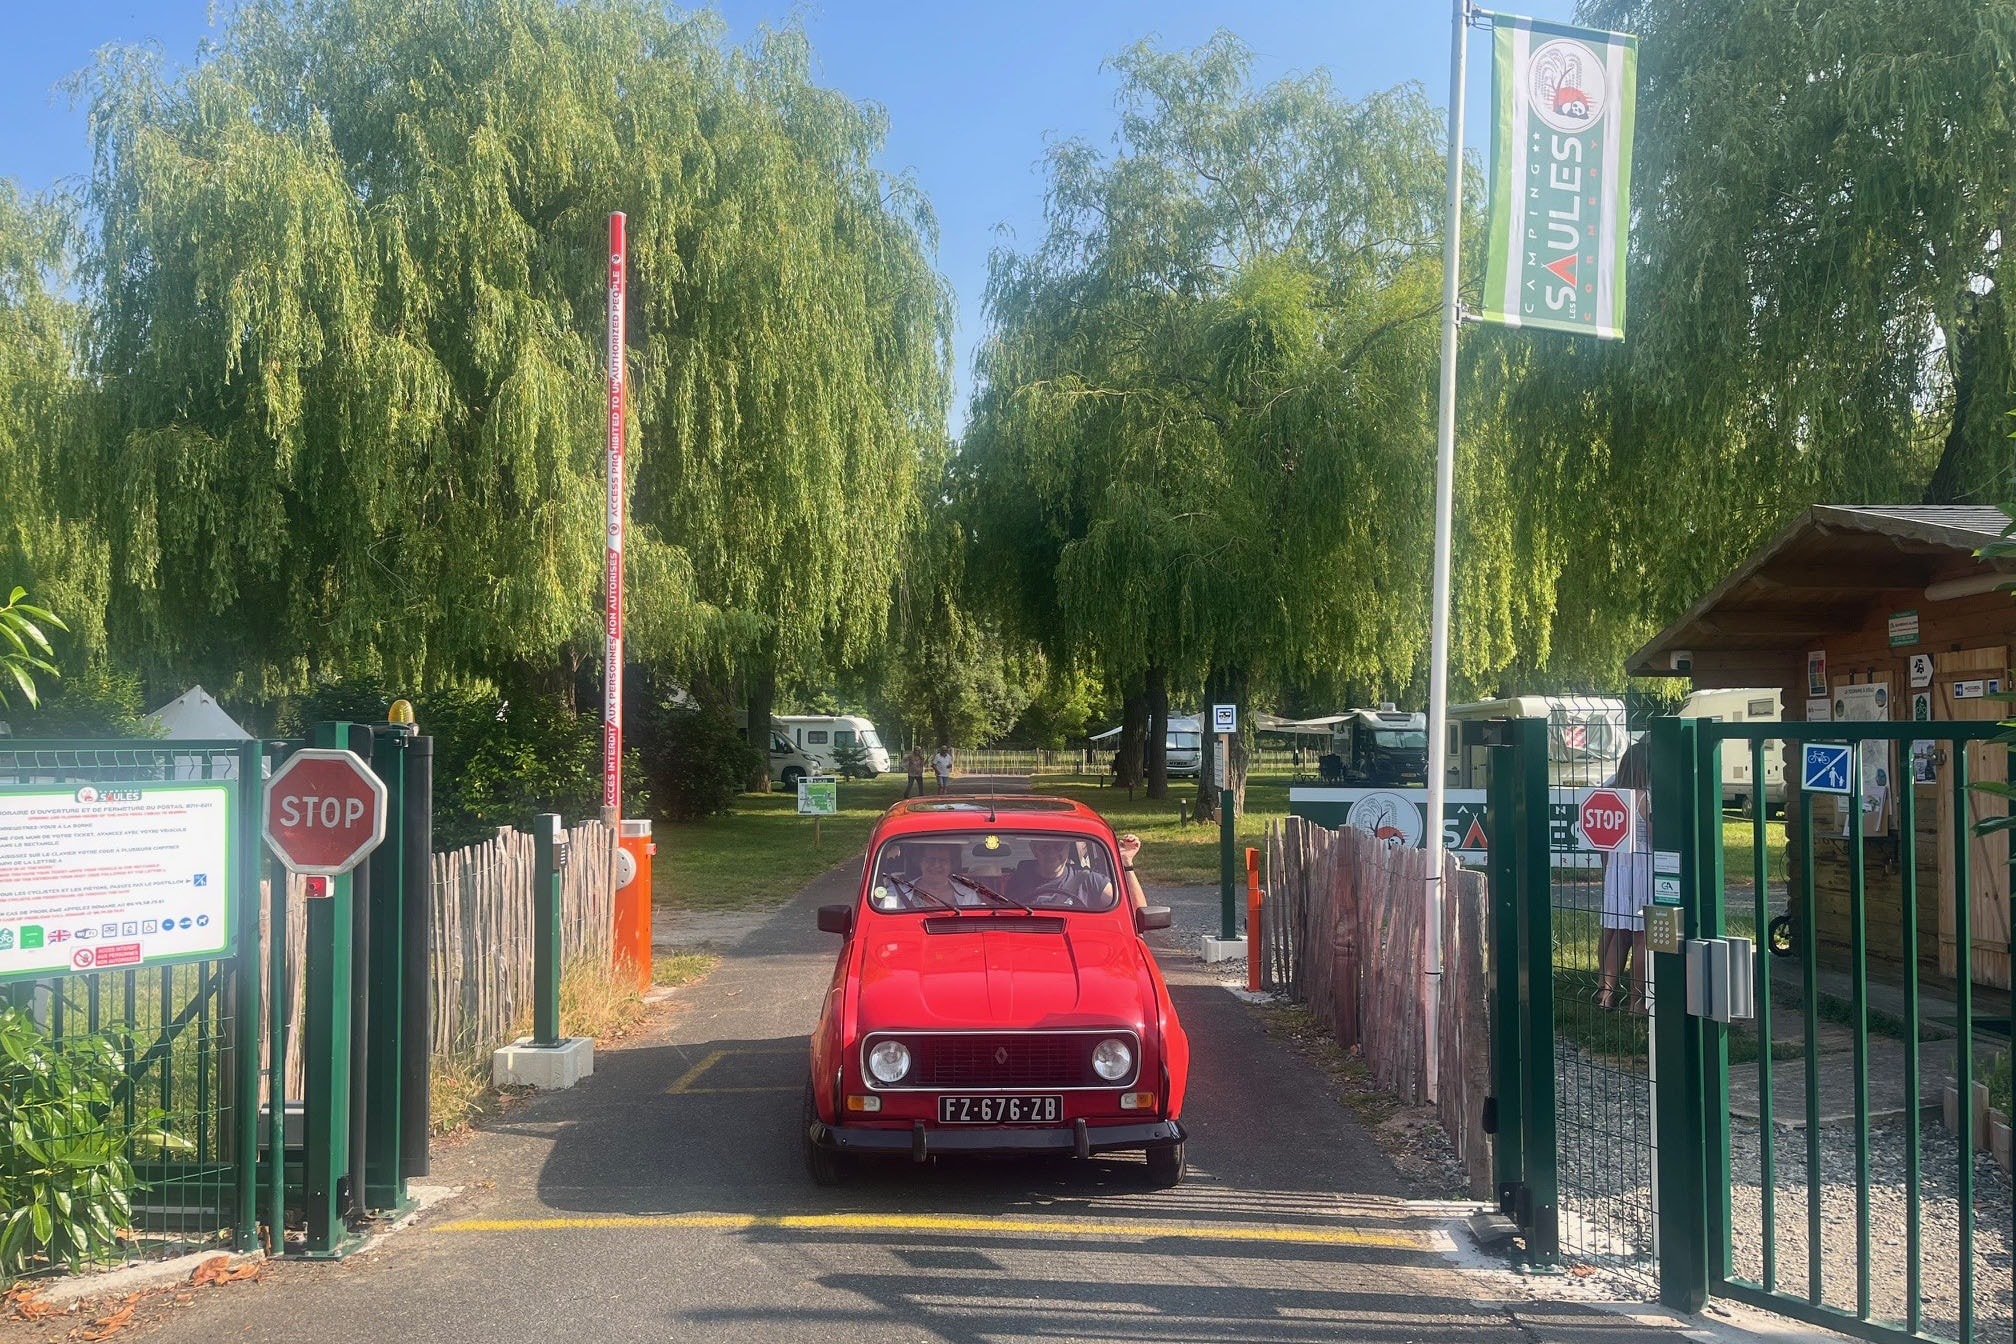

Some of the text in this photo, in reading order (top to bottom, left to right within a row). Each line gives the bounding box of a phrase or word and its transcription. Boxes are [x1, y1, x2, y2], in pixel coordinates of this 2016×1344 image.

[1542, 134, 1583, 311] SAULES
[1525, 164, 1540, 313] CAMPING
[1569, 302, 1577, 319] LES
[610, 271, 620, 517] ACCESS PROHIBITED TO UNAUTHORIZED PEOPLE
[609, 612, 618, 635] NON
[609, 638, 617, 699] PERSONNES
[608, 703, 617, 723] AUX
[607, 727, 617, 772] INTERDIT
[100, 792, 140, 802] SAULES
[280, 795, 365, 829] STOP
[1585, 808, 1625, 831] STOP
[945, 1098, 1056, 1121] FZ-676-ZB
